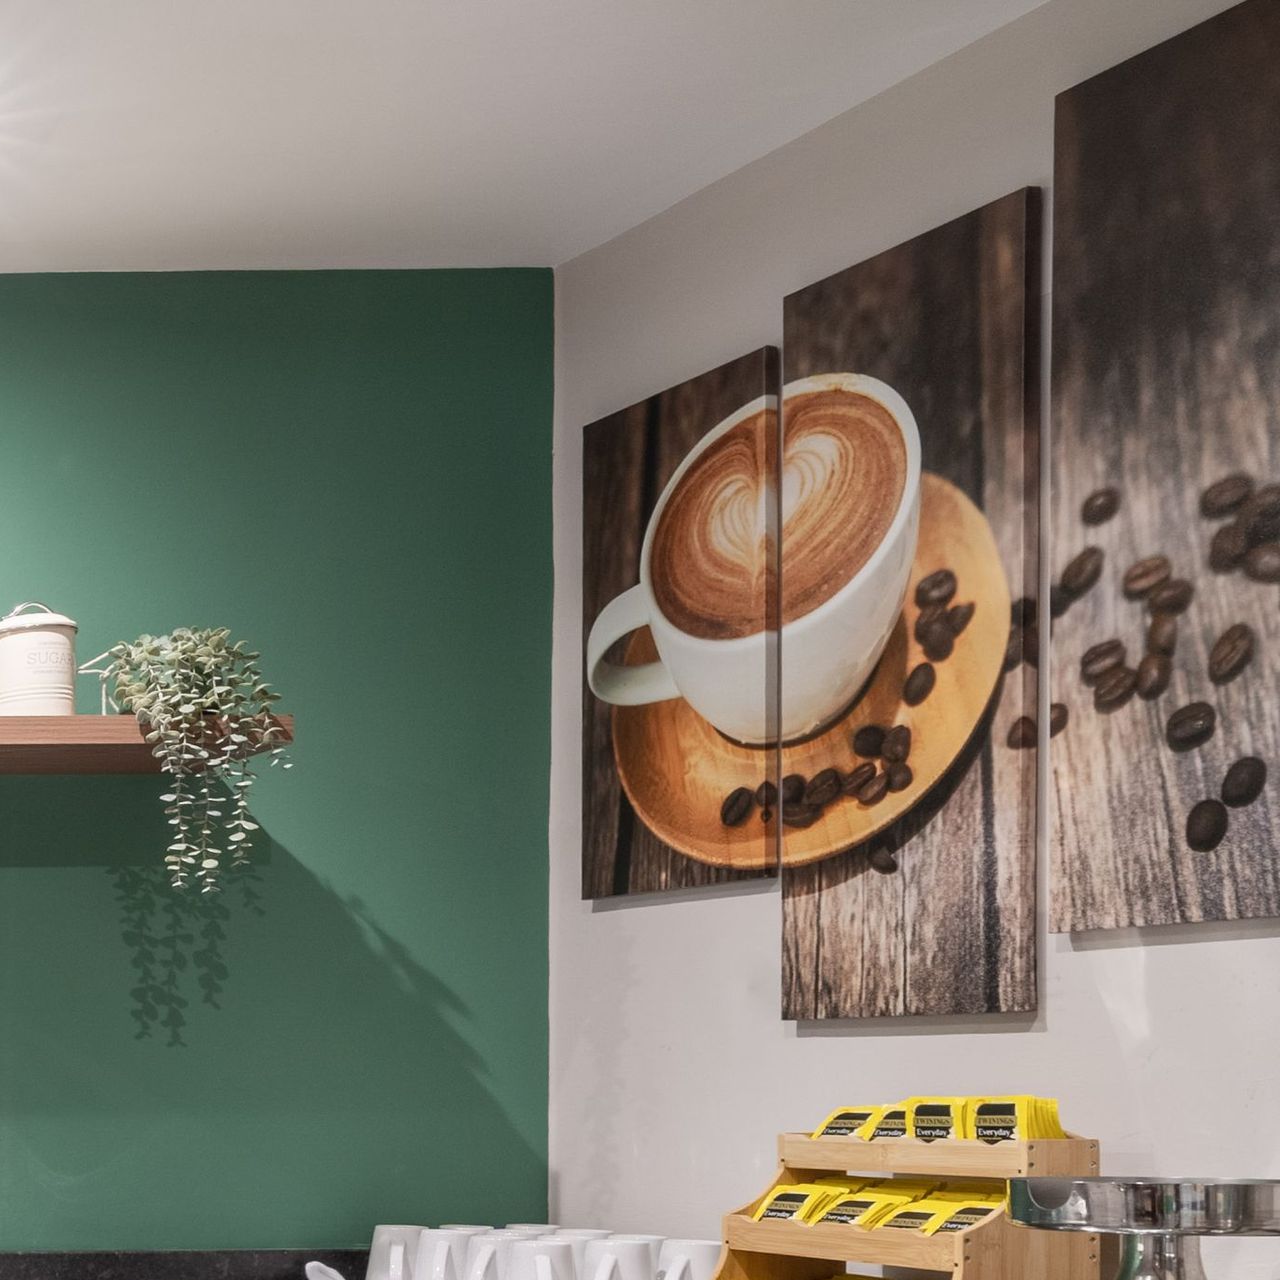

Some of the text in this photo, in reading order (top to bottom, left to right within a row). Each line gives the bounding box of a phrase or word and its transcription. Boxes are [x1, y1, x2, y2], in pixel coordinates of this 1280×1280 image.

[916, 1117, 951, 1125] TWININGS
[977, 1116, 1014, 1125] TWININGS
[916, 1128, 948, 1138] Everyday
[978, 1128, 1011, 1138] Everyday
